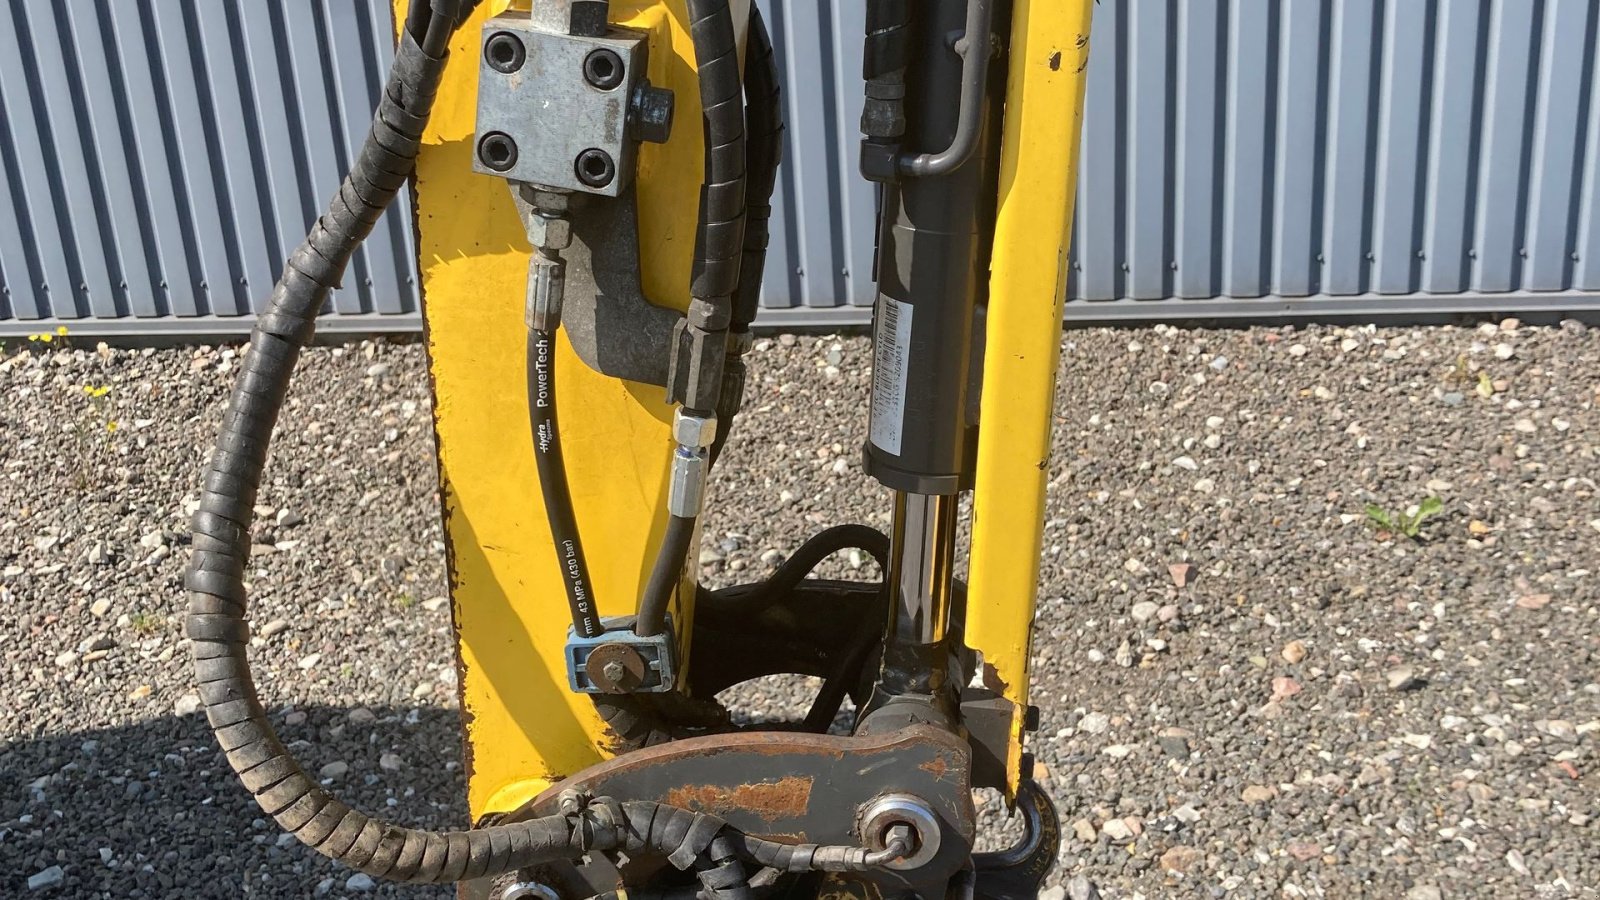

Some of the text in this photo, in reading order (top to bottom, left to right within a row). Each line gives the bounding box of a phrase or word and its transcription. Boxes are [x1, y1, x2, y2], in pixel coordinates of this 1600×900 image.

[536, 339, 548, 407] PowerTech
[538, 424, 549, 453] Hydra
[562, 539, 593, 634] mm 43 MPa (430 bar)
